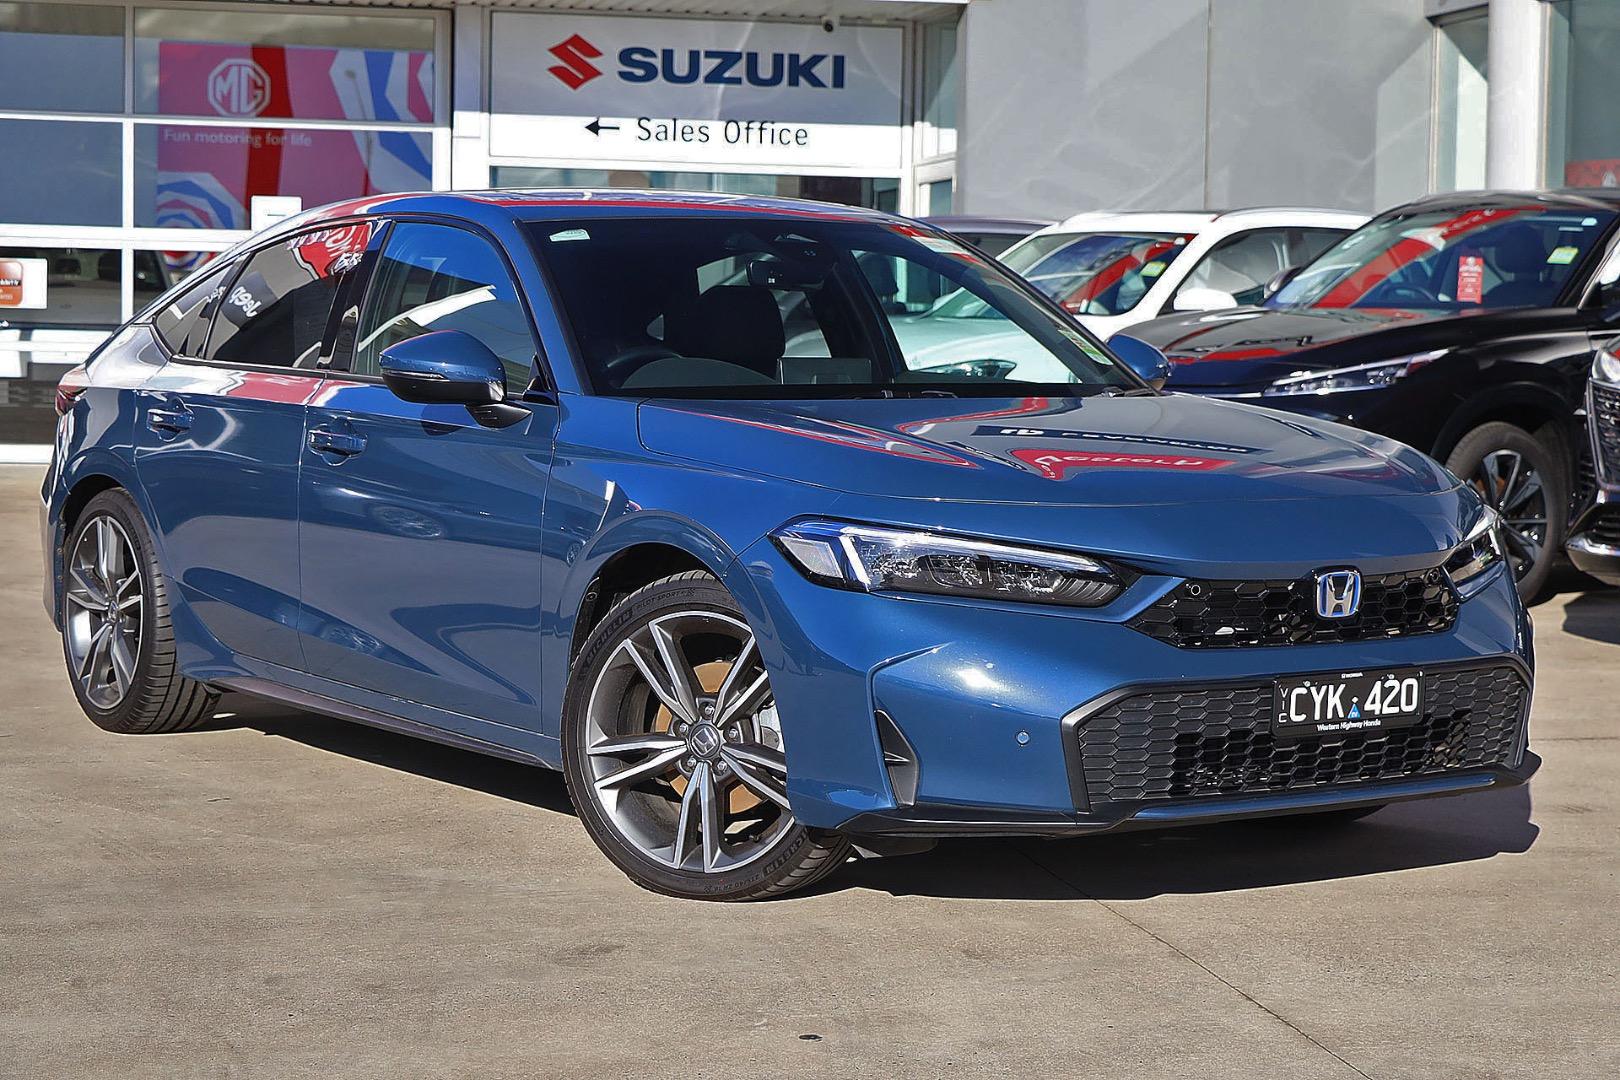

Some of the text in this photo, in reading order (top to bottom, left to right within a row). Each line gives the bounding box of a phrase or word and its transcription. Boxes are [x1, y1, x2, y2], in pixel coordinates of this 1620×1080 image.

[213, 62, 265, 114] MG
[617, 46, 846, 89] SUZUKI
[163, 128, 312, 148] Fun motoring for life
[637, 117, 809, 146] Sales Office
[1290, 678, 1418, 722] CYK 420
